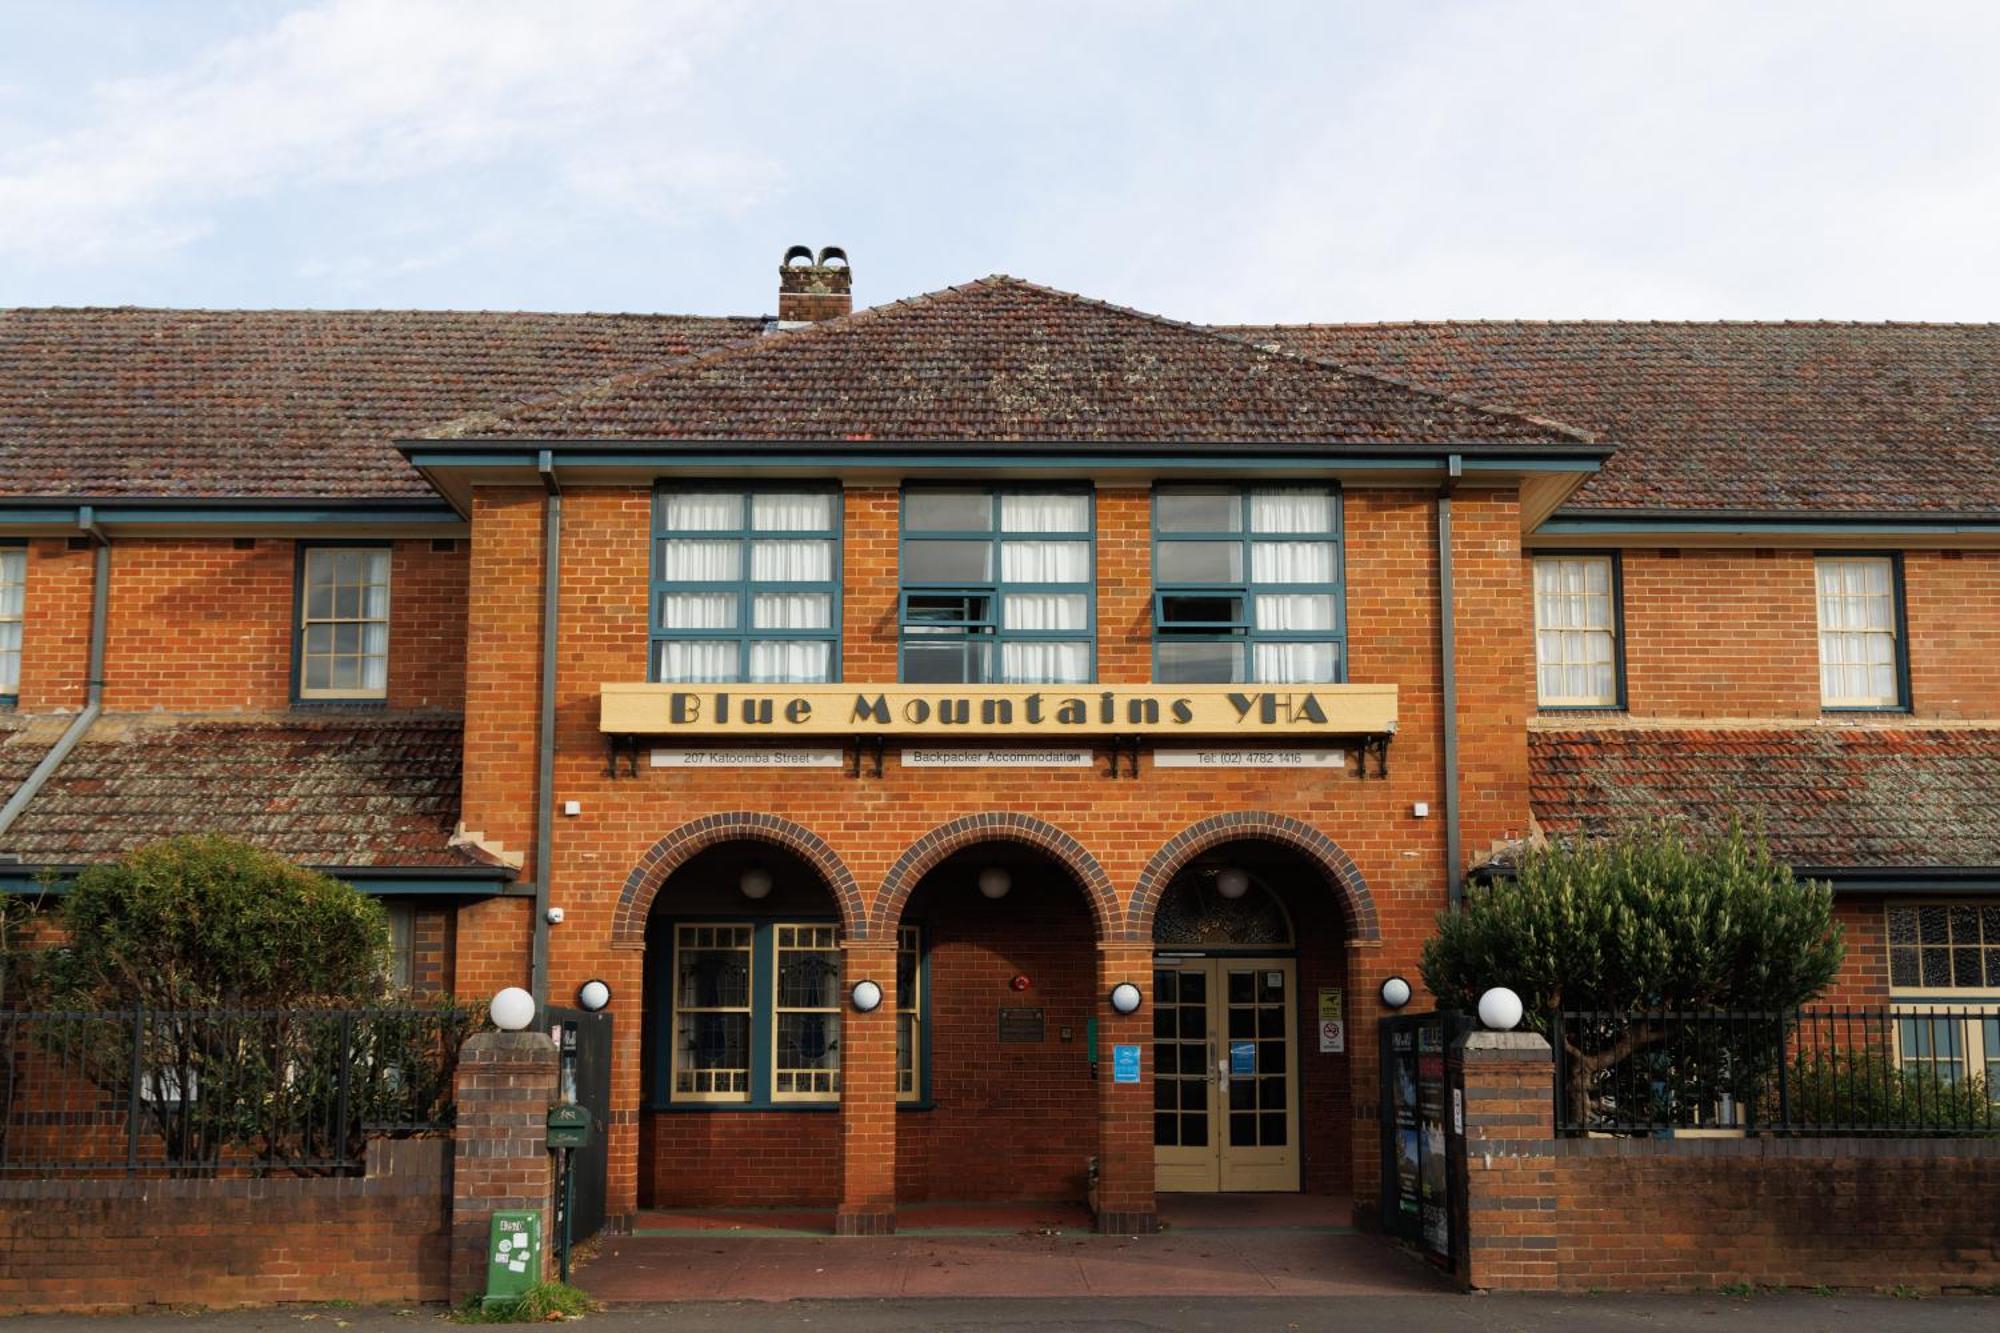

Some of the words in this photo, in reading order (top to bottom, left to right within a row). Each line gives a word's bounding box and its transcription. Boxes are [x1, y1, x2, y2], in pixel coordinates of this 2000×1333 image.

[670, 692, 813, 725] Blue
[849, 691, 1193, 725] Mountains
[1227, 692, 1328, 725] YHA
[684, 752, 705, 764] 207
[709, 752, 771, 764] Katoomba
[774, 752, 810, 764] Street
[913, 751, 982, 765] Backpacker
[986, 751, 1081, 763] Accommodation
[1220, 752, 1242, 766] (02)
[1246, 752, 1273, 764] 4782
[1278, 752, 1302, 764] 1416
